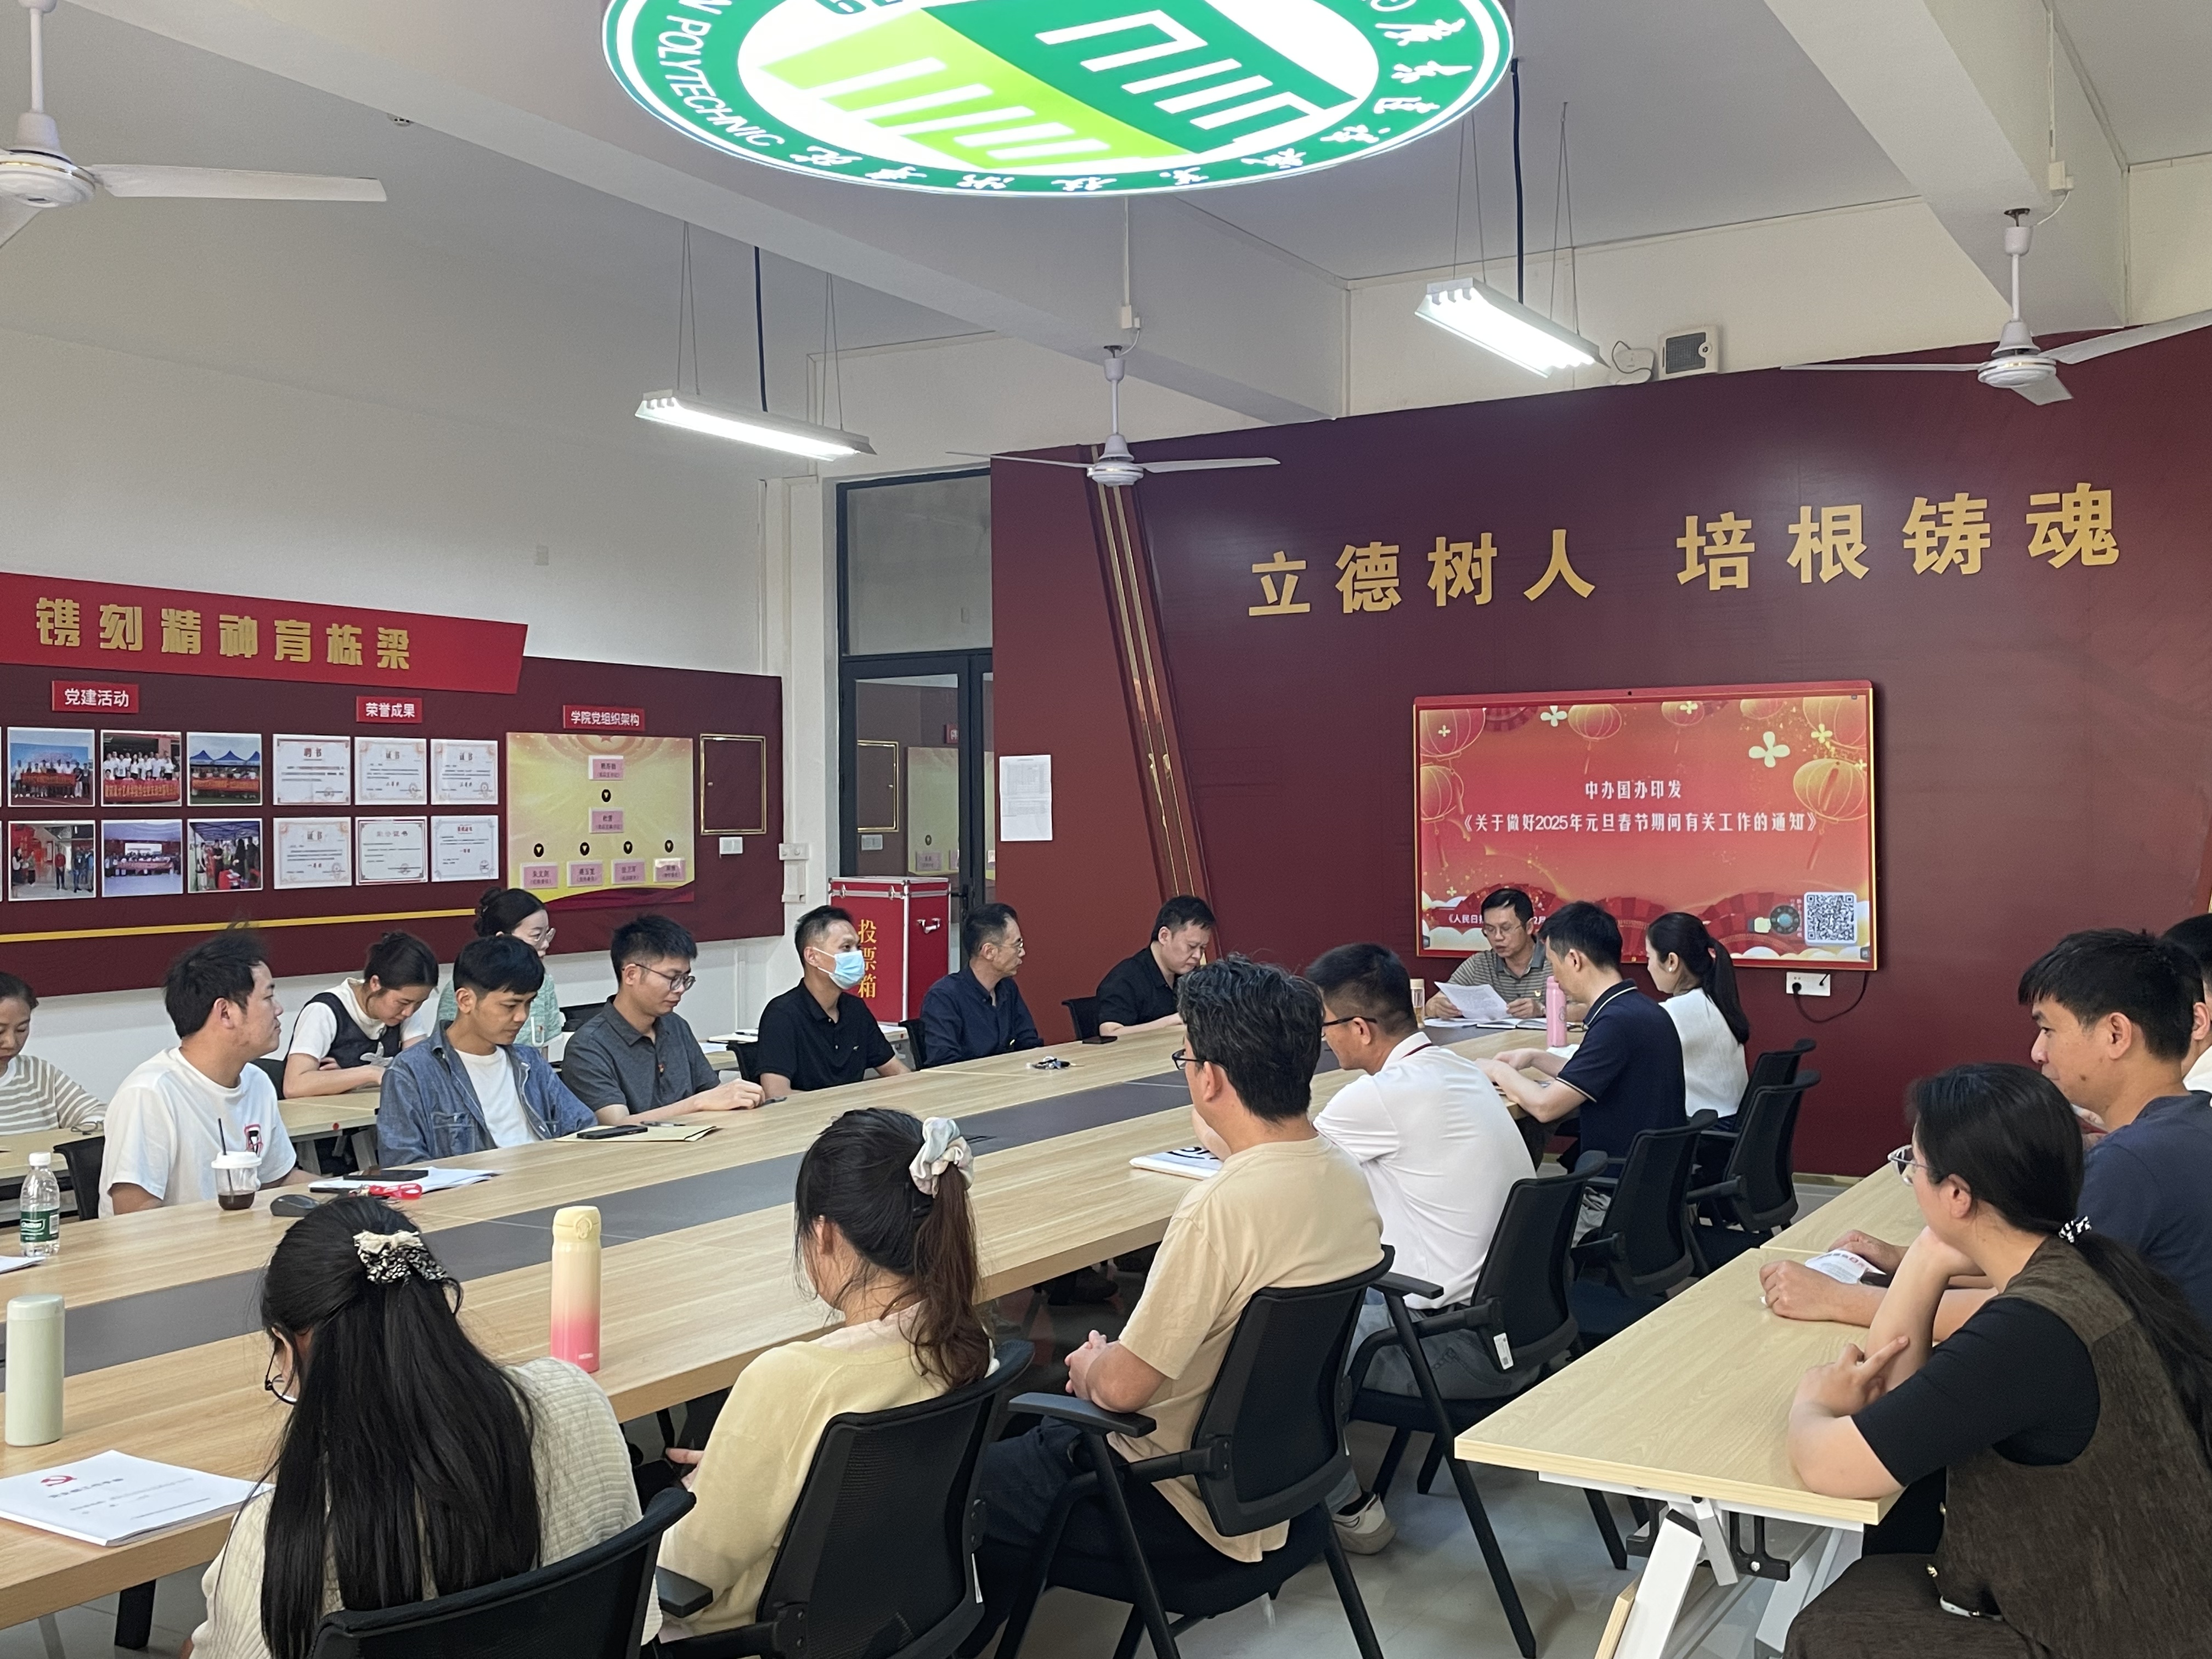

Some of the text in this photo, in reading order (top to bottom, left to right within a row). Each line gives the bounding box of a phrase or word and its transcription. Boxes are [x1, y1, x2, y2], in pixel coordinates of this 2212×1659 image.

[658, 15, 785, 146] POLYTECHNIC
[1248, 482, 2120, 617] 立德树人 培根铸魂
[36, 597, 410, 670] 镌刻精神育栋梁
[64, 689, 129, 708] 党建活动
[365, 702, 415, 718] 荣誉成果
[571, 711, 640, 727] 学院党组织架构
[1585, 780, 1682, 800] 中办国办印发
[1464, 812, 1819, 833] 《关于做好2025年元旦春节期间有关工作的通知》
[858, 919, 877, 998] 投票箱
